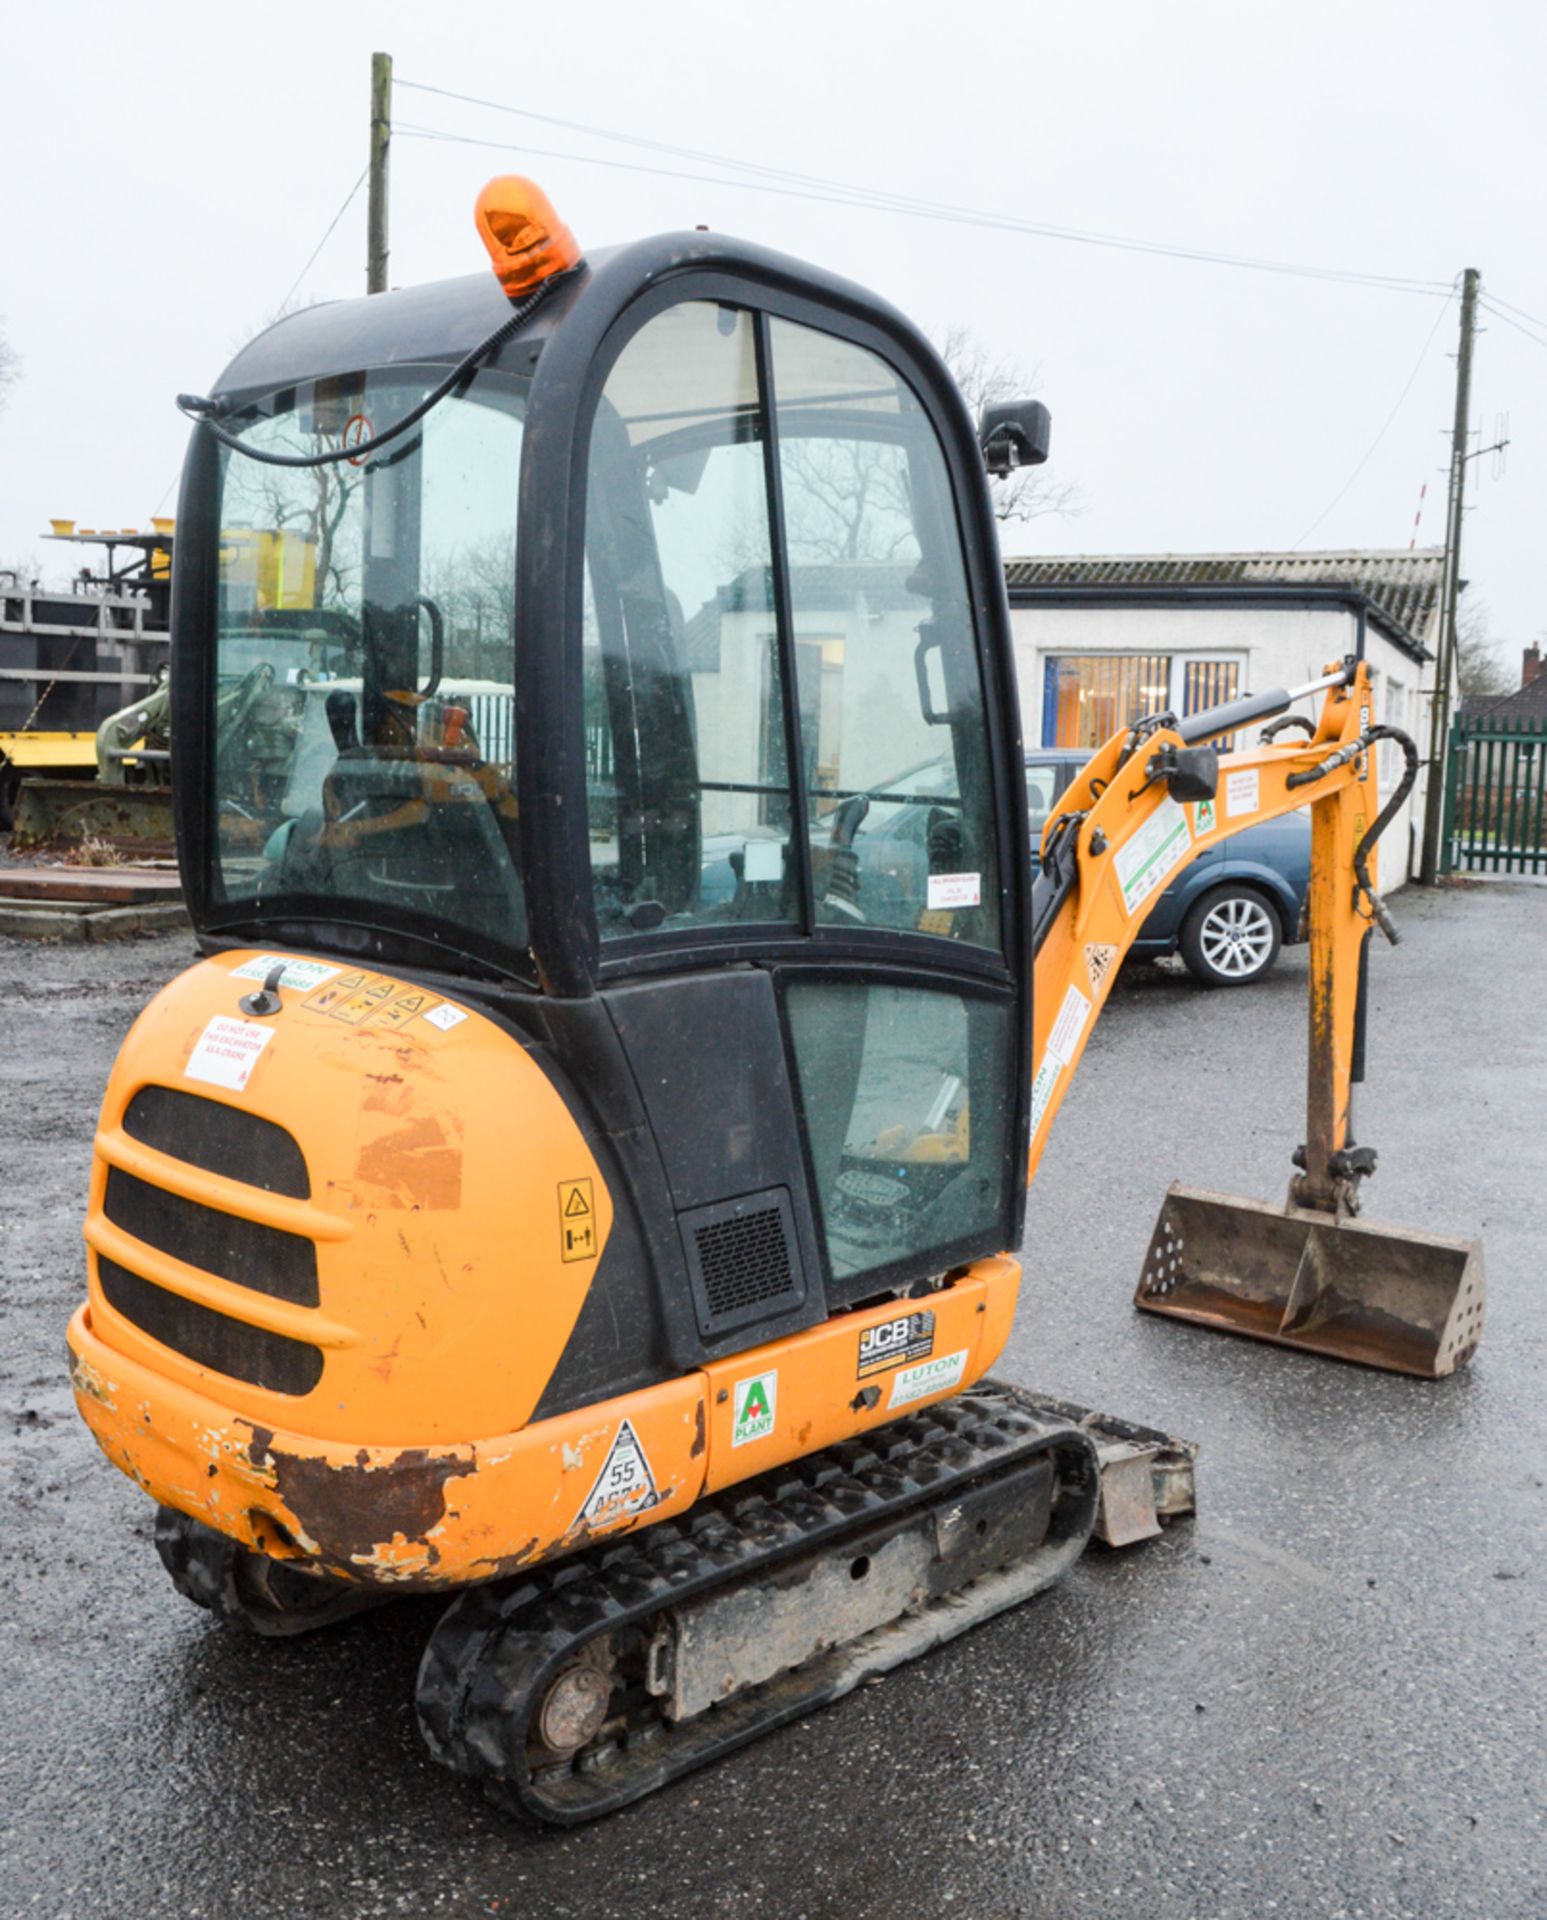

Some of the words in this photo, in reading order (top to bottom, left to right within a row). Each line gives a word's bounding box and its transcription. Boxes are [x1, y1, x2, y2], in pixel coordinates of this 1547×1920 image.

[216, 1022, 229, 1032] DO
[230, 1025, 246, 1035] NOT
[245, 1030, 260, 1039] USE
[219, 1035, 262, 1051] EXCAVATOR
[221, 1048, 247, 1060] CRANE
[860, 1318, 908, 1352] JCB
[902, 1354, 960, 1385] LUTON
[739, 1380, 770, 1425] A
[735, 1417, 771, 1441] PLANT
[610, 1460, 635, 1487] 55
